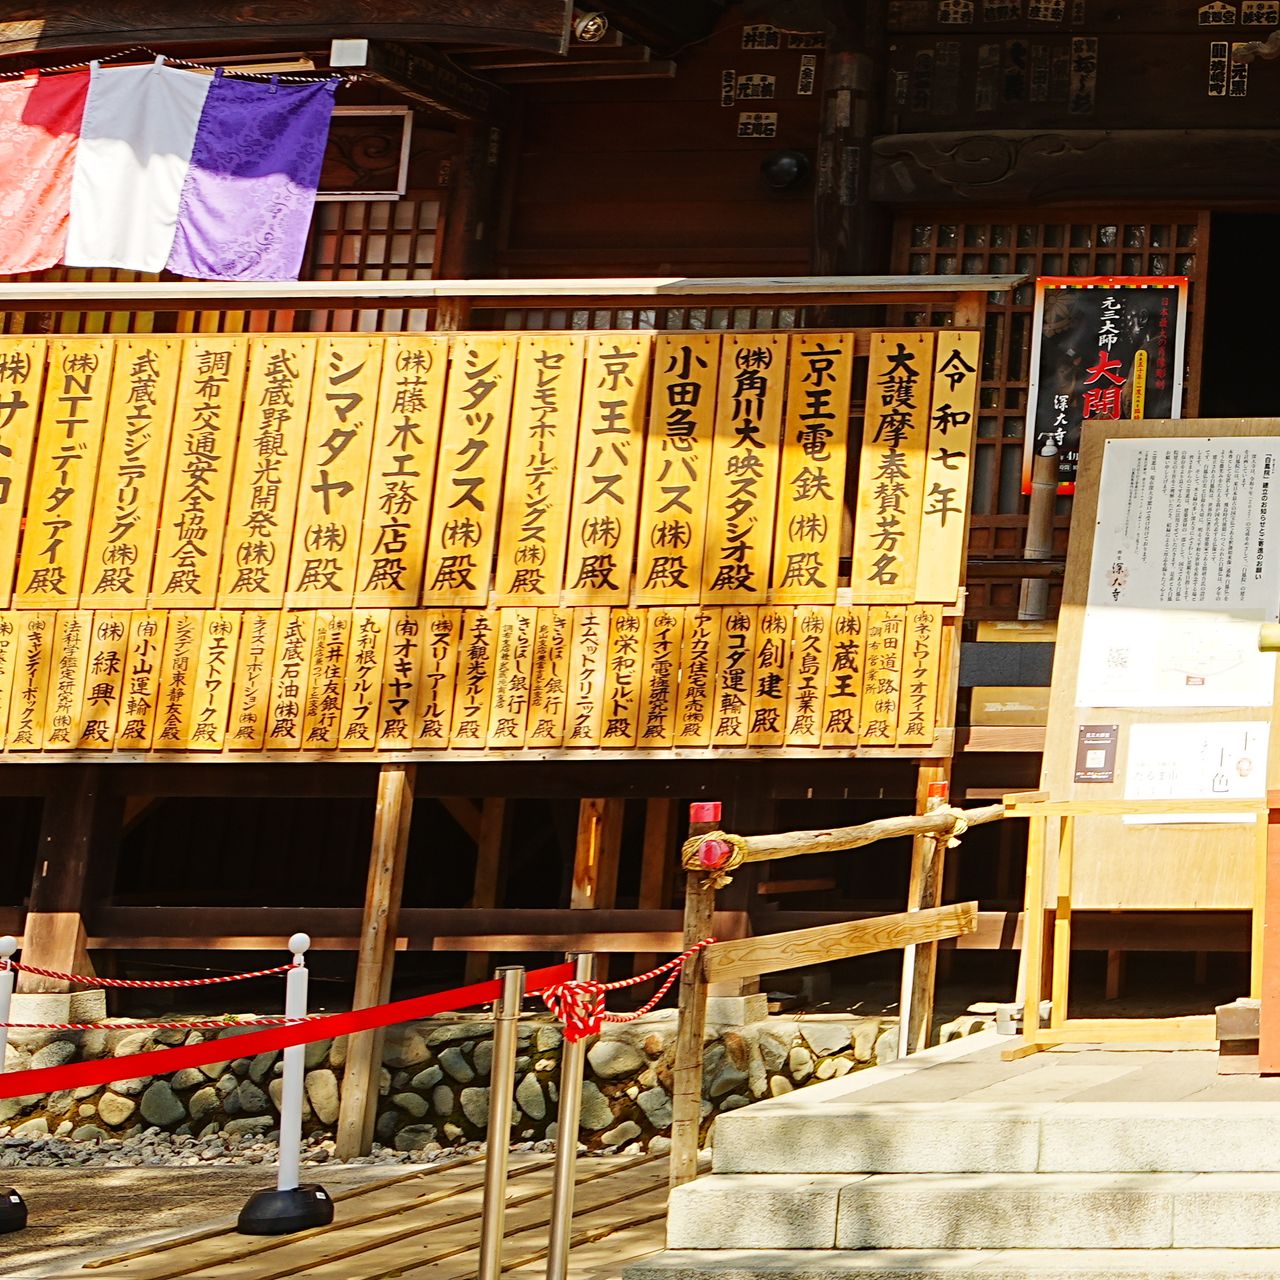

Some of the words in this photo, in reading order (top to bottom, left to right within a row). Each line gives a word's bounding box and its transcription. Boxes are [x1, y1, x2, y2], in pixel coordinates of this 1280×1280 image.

[924, 348, 976, 528] 令和七年
[1054, 394, 1069, 446] 深大寺
[1098, 296, 1121, 351] 元三大師
[161, 349, 232, 596] 調布交通安全協会殿
[288, 352, 367, 593] シマダヤ(株)殿
[429, 349, 499, 592] シダックス(株)殿
[571, 344, 638, 592] 京王バス(株)殿
[643, 344, 708, 591] 小田急バス(株)殿
[866, 342, 920, 587] 大護摩奉賛芳名
